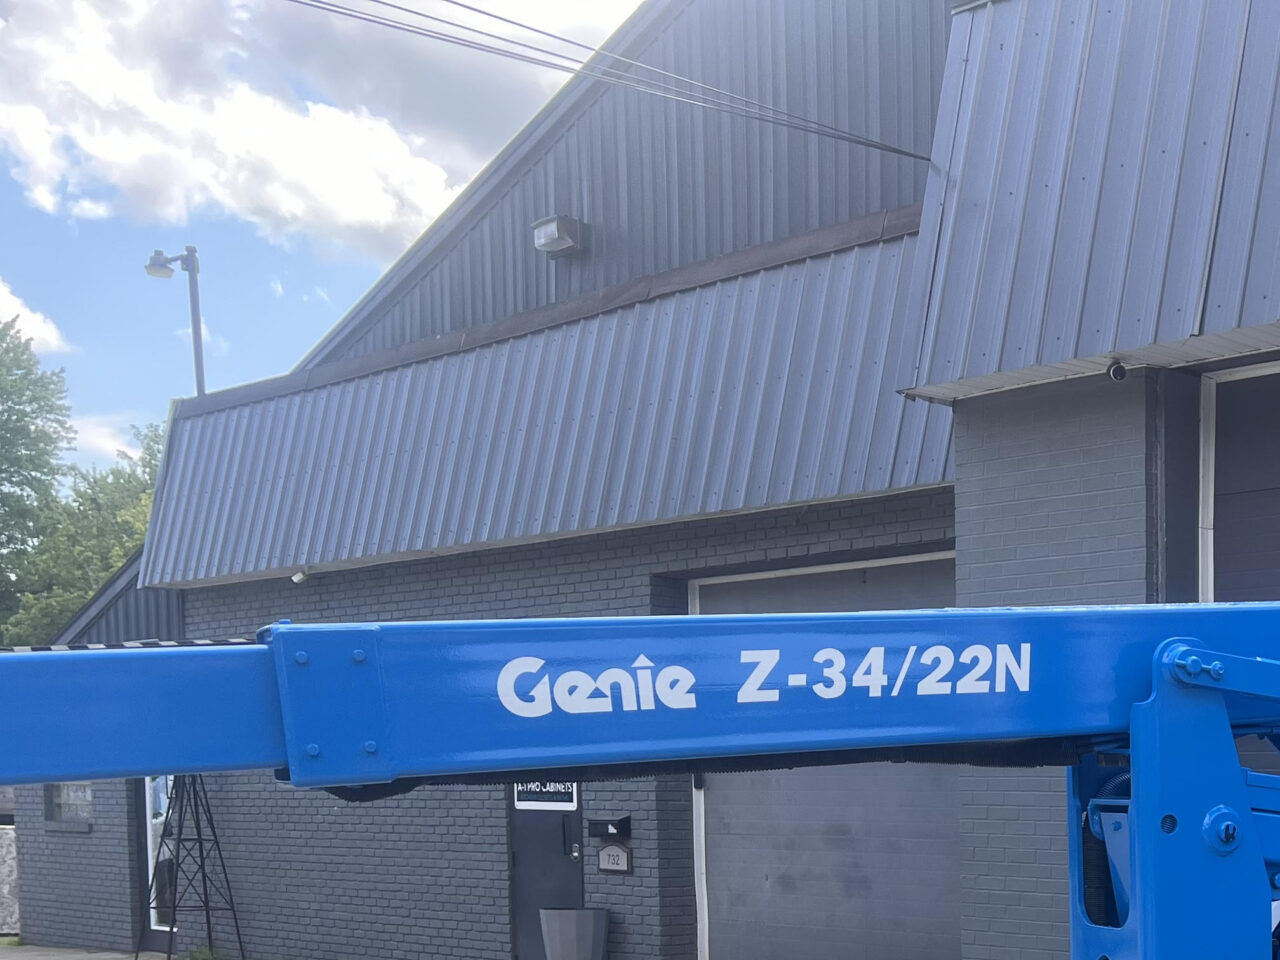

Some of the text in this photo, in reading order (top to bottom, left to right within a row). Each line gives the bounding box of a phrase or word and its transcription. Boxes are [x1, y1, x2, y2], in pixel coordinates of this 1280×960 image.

[496, 642, 1032, 718] Genie Z-34/22N
[606, 853, 621, 866] 732
